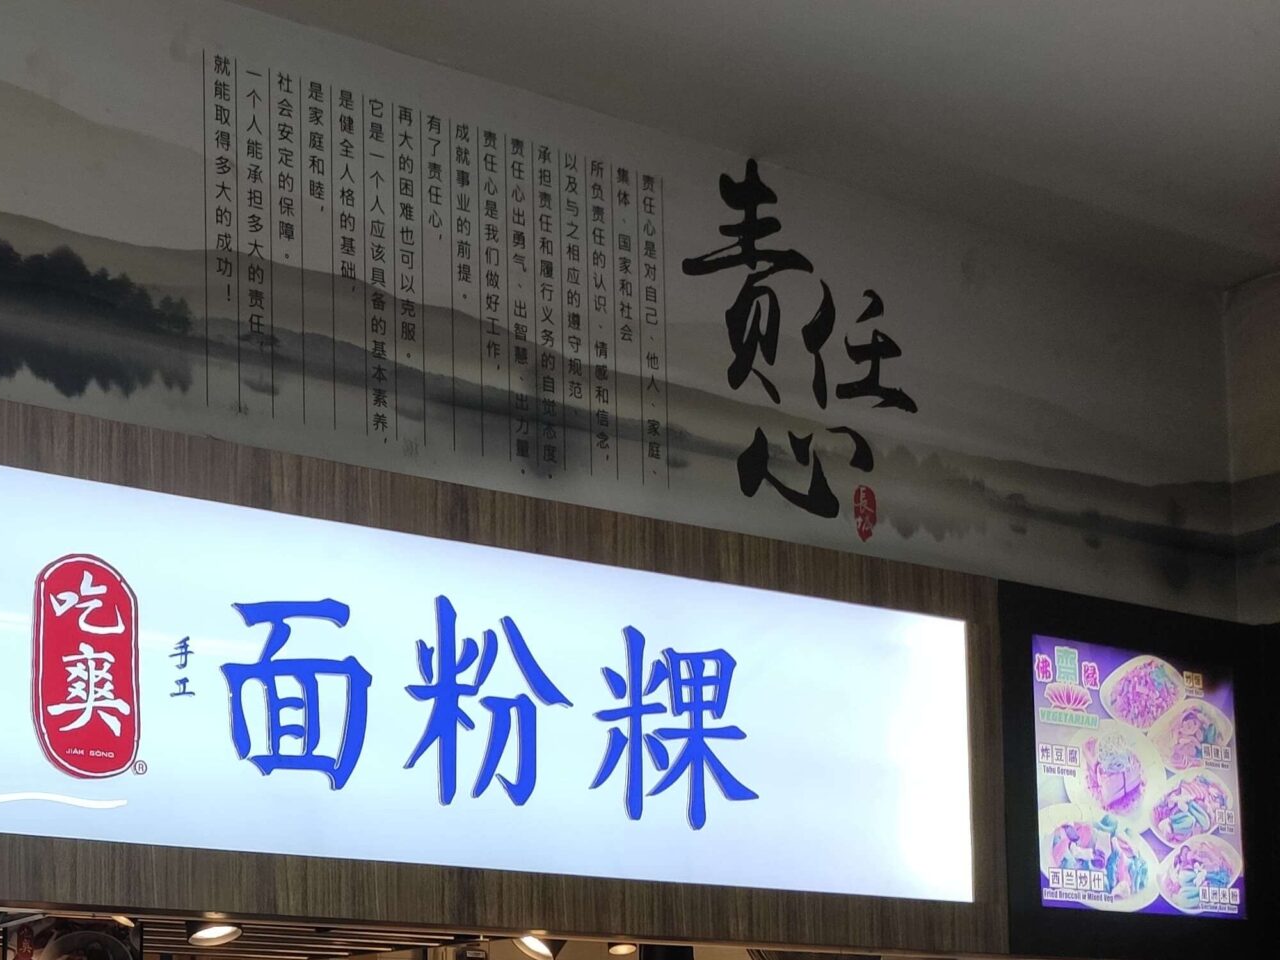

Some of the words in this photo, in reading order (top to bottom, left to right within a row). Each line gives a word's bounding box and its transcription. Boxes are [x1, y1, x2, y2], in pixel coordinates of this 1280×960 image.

[48, 570, 130, 737] 吃爽
[169, 636, 196, 697] 手工
[221, 594, 760, 830] 面粉粿
